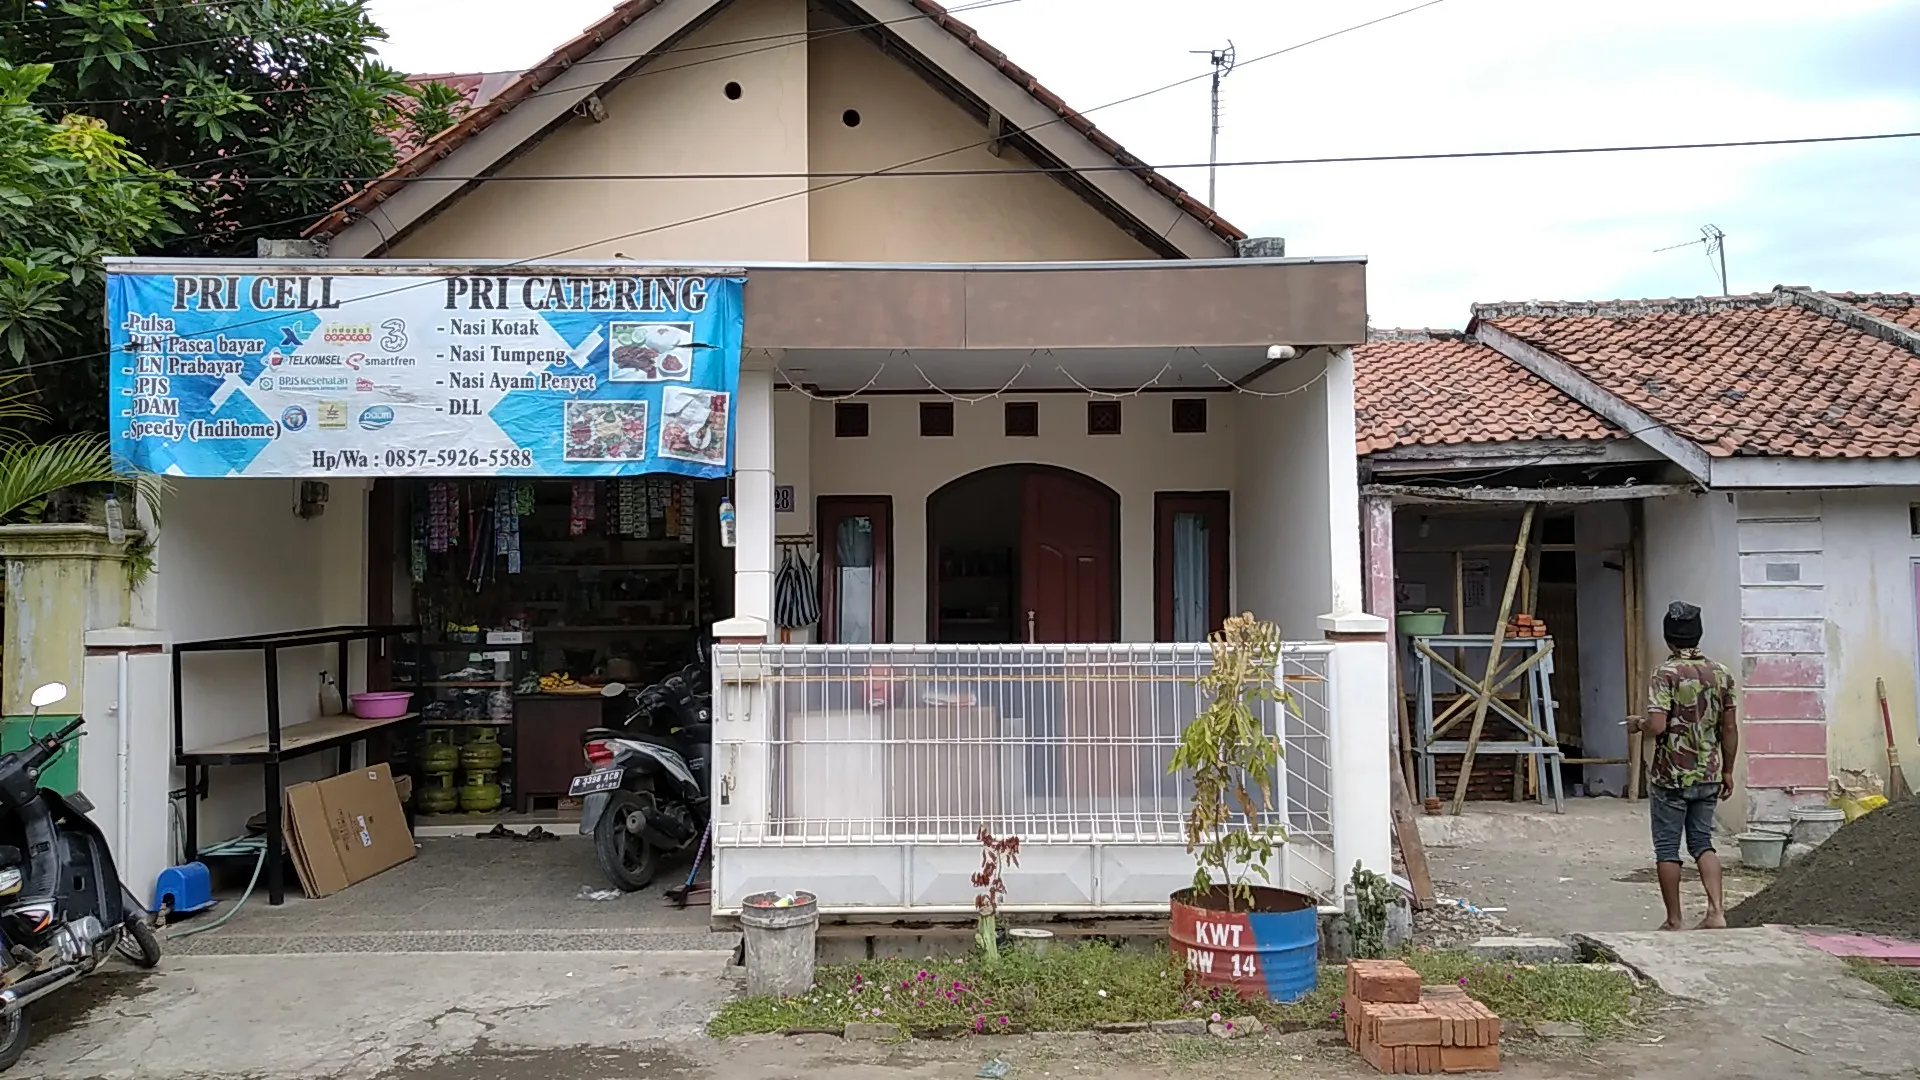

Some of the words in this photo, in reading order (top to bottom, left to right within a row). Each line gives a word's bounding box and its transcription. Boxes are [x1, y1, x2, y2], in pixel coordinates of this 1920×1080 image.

[173, 276, 239, 309] PRI
[252, 276, 340, 310] CELL
[444, 277, 510, 310] PRI
[522, 277, 706, 311] CATERING
[450, 319, 485, 335] Nasi
[492, 319, 539, 335] Kotak
[129, 334, 162, 352] PLN
[168, 336, 213, 352] Pasca
[218, 336, 264, 355] bayar
[287, 355, 342, 366] TELKOMSEL
[365, 355, 416, 366] smartfren
[449, 346, 485, 361] Nasi
[491, 346, 566, 365] Tumpeng
[136, 356, 162, 373] LN
[168, 357, 242, 376] Prabayar
[278, 376, 300, 386] BPJS
[301, 376, 348, 386] Kesehatan
[449, 372, 484, 388] Nasi
[489, 373, 534, 392] Ayam
[540, 373, 595, 392] Penyet
[448, 399, 482, 416] DLL
[130, 420, 185, 439] Speedy
[189, 420, 281, 440] (Indihome)
[312, 450, 367, 470] Hp/Wa
[385, 449, 532, 468] 0857-5926-5588
[1195, 920, 1244, 948] KWT
[1186, 947, 1214, 974] RW
[1231, 953, 1256, 978] 14
